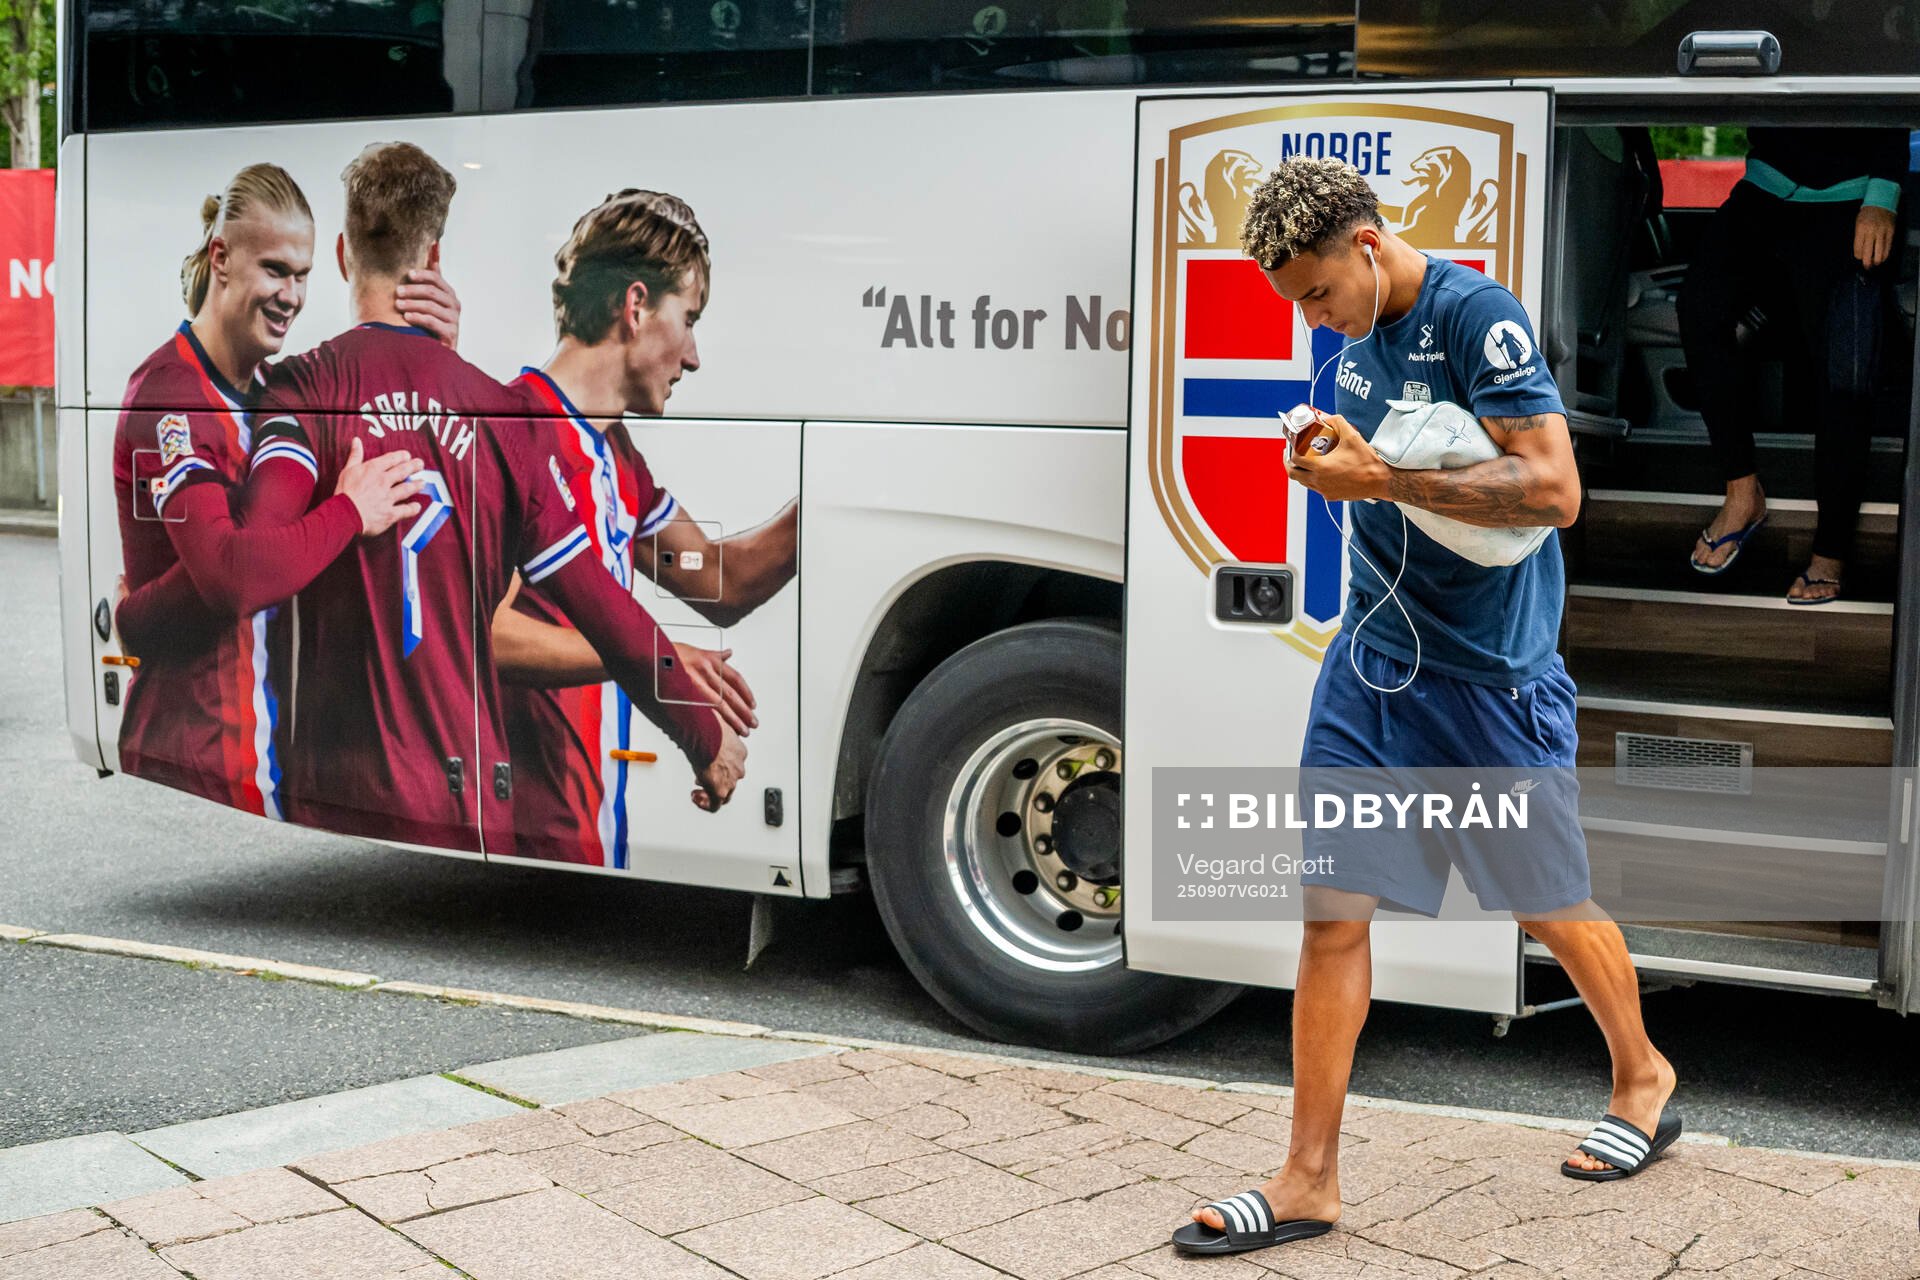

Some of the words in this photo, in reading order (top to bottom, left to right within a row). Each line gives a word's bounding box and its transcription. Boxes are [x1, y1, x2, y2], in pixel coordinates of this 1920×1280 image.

[1281, 131, 1392, 175] NORGE
[971, 295, 1047, 350] for
[1065, 295, 1131, 352] No
[1510, 687, 1519, 700] 3
[1513, 779, 1533, 792] NIKE
